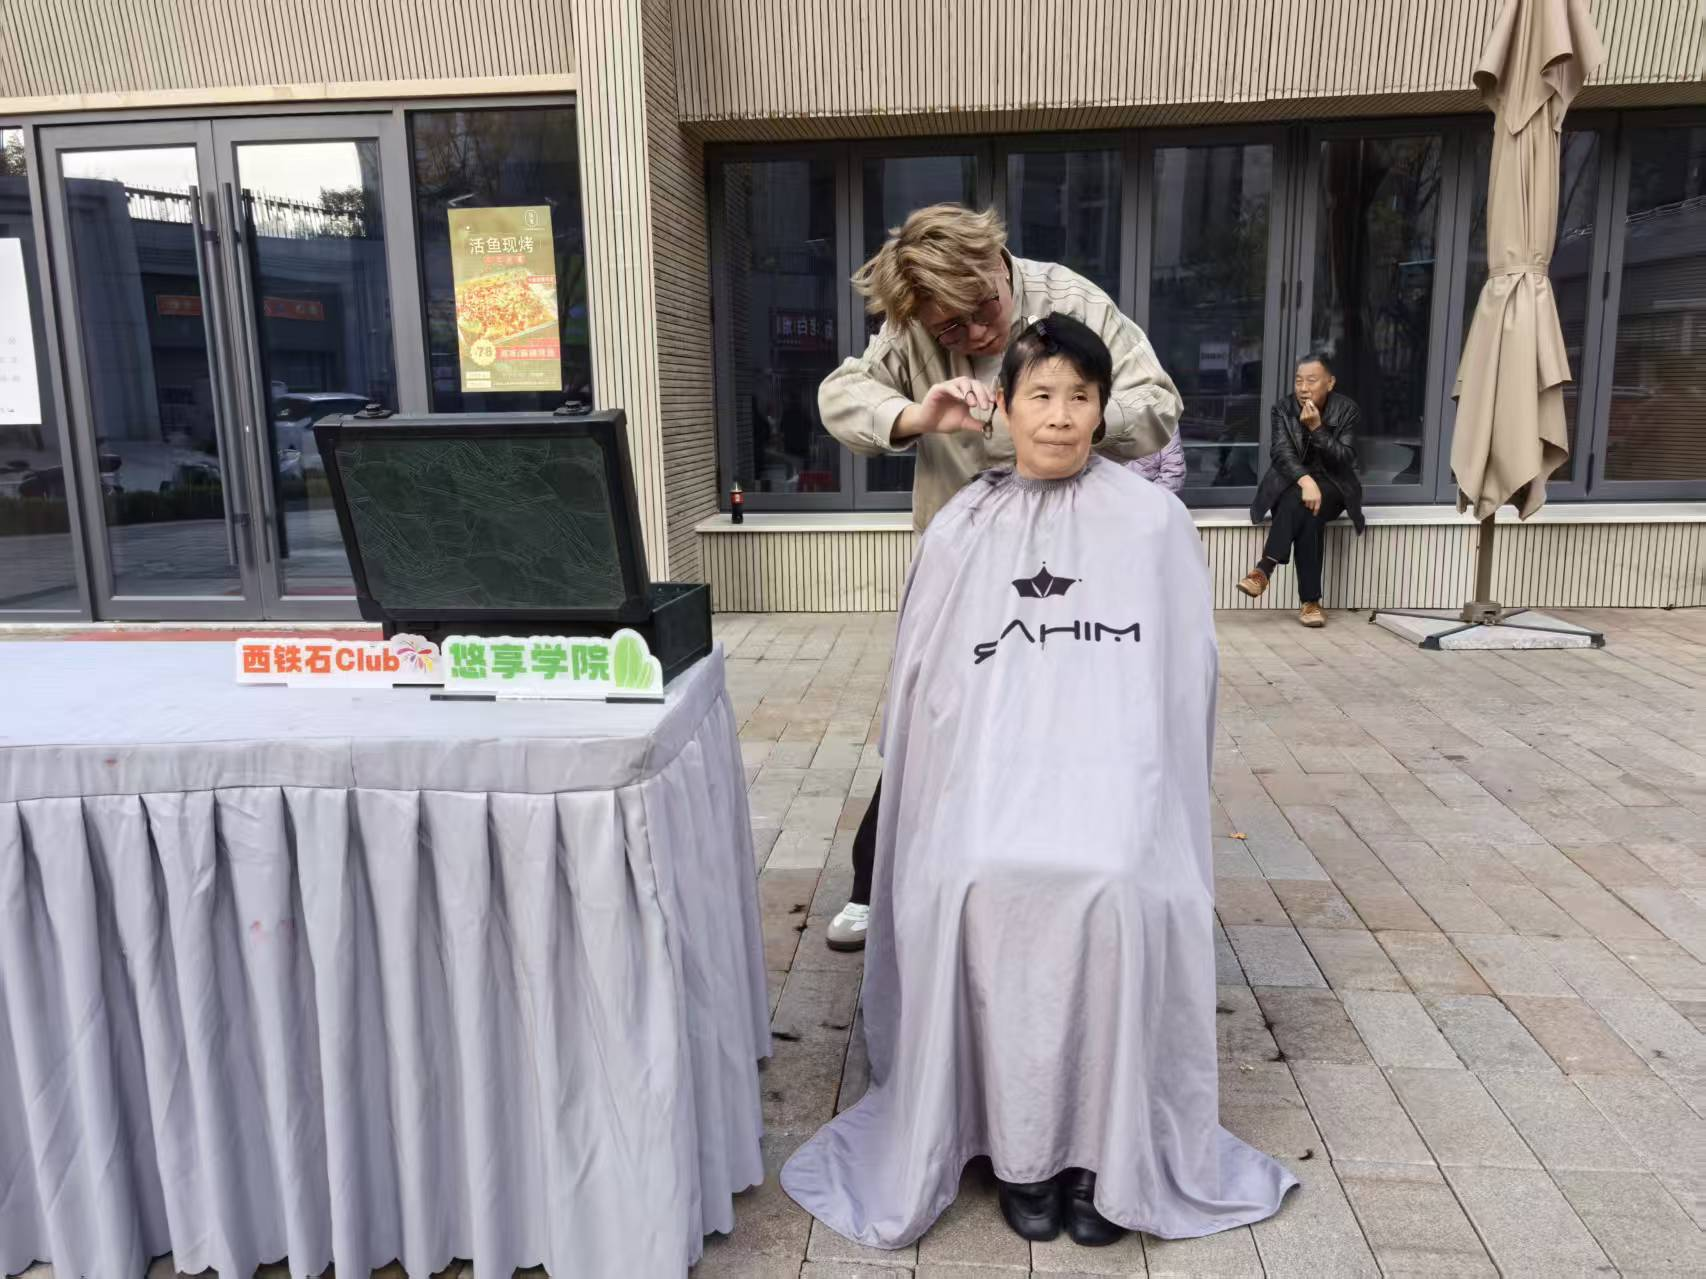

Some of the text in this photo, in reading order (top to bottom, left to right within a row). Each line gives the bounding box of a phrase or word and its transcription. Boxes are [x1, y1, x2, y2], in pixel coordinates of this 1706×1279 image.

[469, 236, 534, 254] 活鱼现烤
[449, 642, 610, 680] 悠享学院
